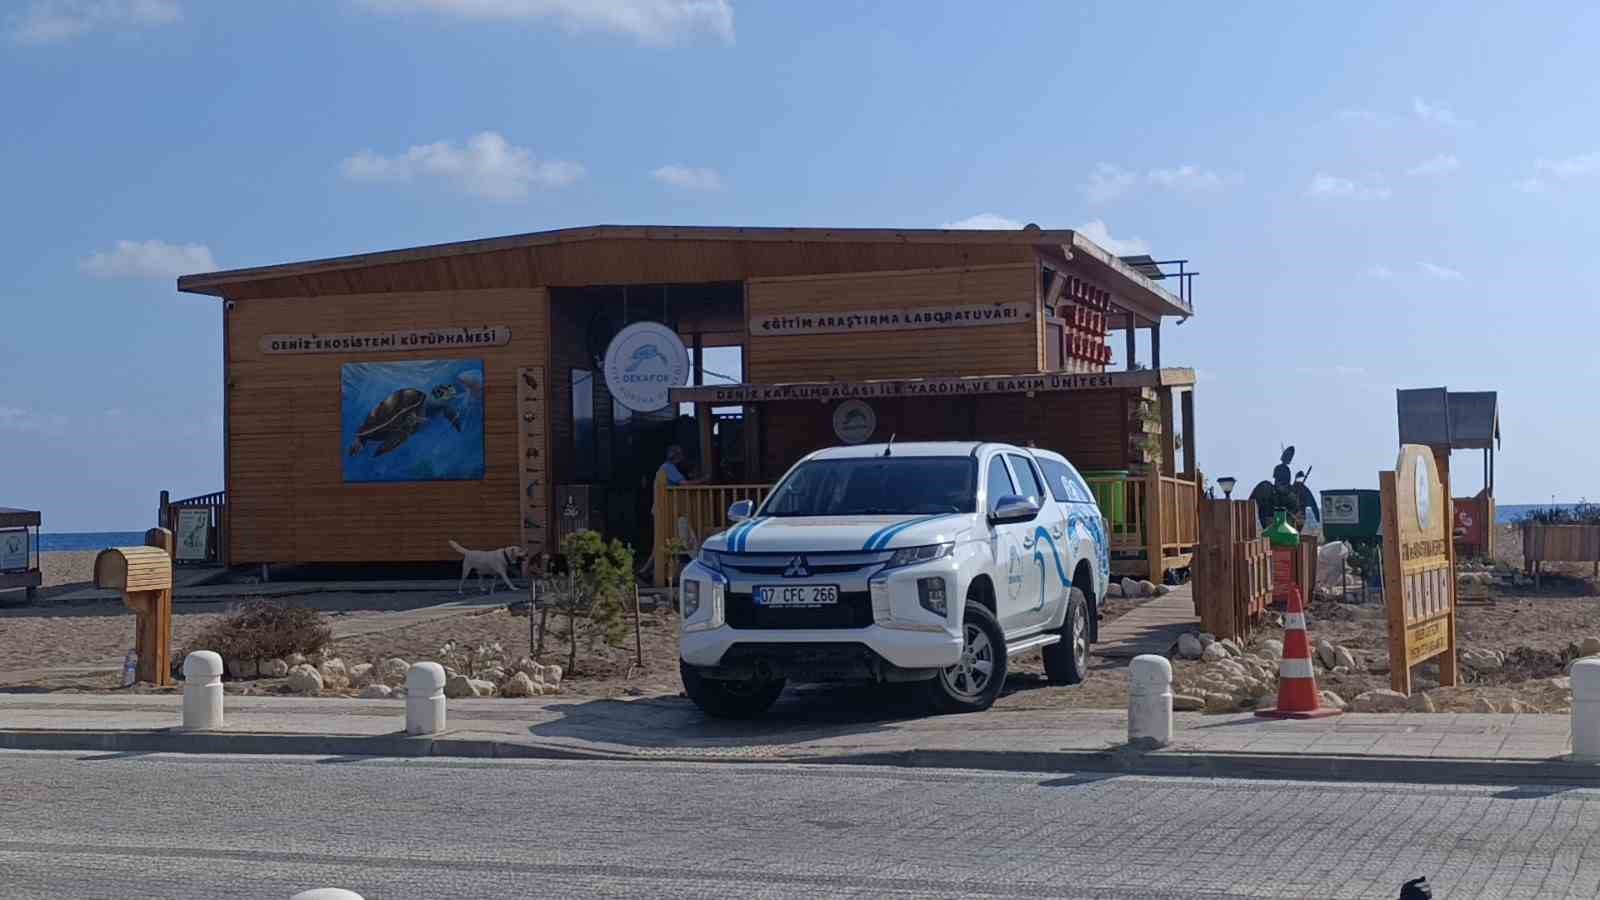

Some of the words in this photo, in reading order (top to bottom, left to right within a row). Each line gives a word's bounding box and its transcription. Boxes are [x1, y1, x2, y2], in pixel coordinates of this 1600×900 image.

[762, 316, 812, 330] EĞİTİM
[818, 314, 898, 328] ARAŞTIRMA
[904, 308, 1017, 323] LABORATUVARI
[271, 338, 311, 350] DENİZ
[316, 334, 395, 349] EKOSİSTEMİ
[401, 330, 496, 345] KÜTÜPHANESİ
[716, 390, 759, 401] DENİZ
[763, 385, 875, 399] KAPLUMBAĞASI
[909, 381, 968, 394] YARDIM
[970, 381, 989, 392] VE
[997, 379, 1045, 391] BAKIM
[1051, 375, 1113, 389] ÜNİTESİ
[761, 588, 776, 602] 07
[783, 588, 805, 602] CFC
[813, 587, 836, 602] 266
